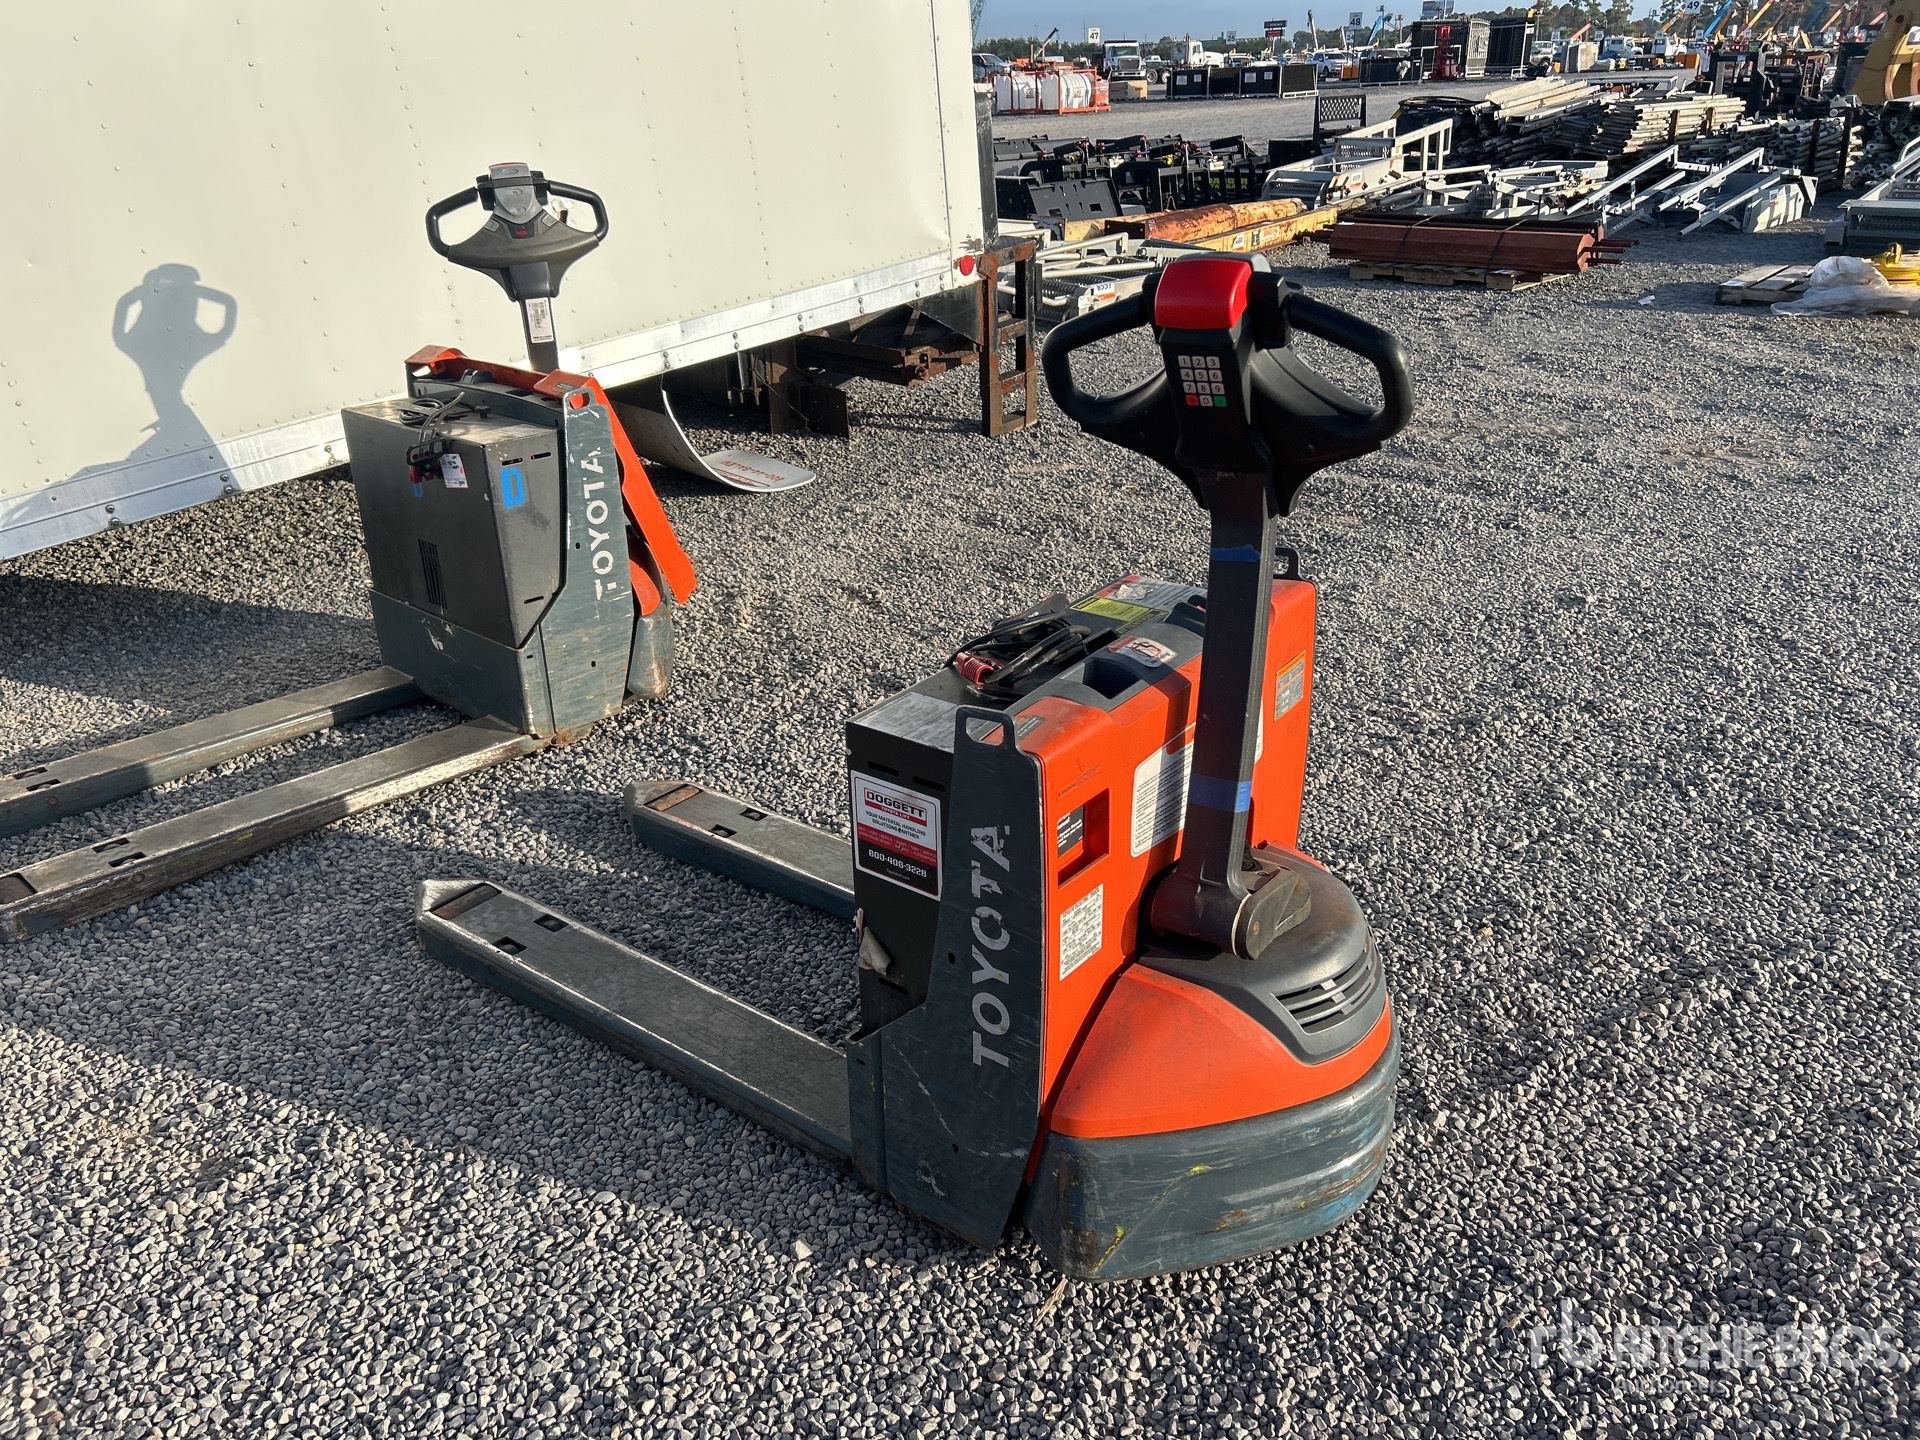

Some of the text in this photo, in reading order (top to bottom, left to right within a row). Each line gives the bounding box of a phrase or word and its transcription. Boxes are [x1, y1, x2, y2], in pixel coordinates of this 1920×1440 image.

[1686, 0, 1700, 10] 49
[1350, 17, 1361, 26] 48
[1089, 32, 1099, 40] 47
[581, 446, 618, 602] TOYOTA
[866, 790, 925, 818] DOGGETT
[971, 824, 1012, 1070] TOYOTA
